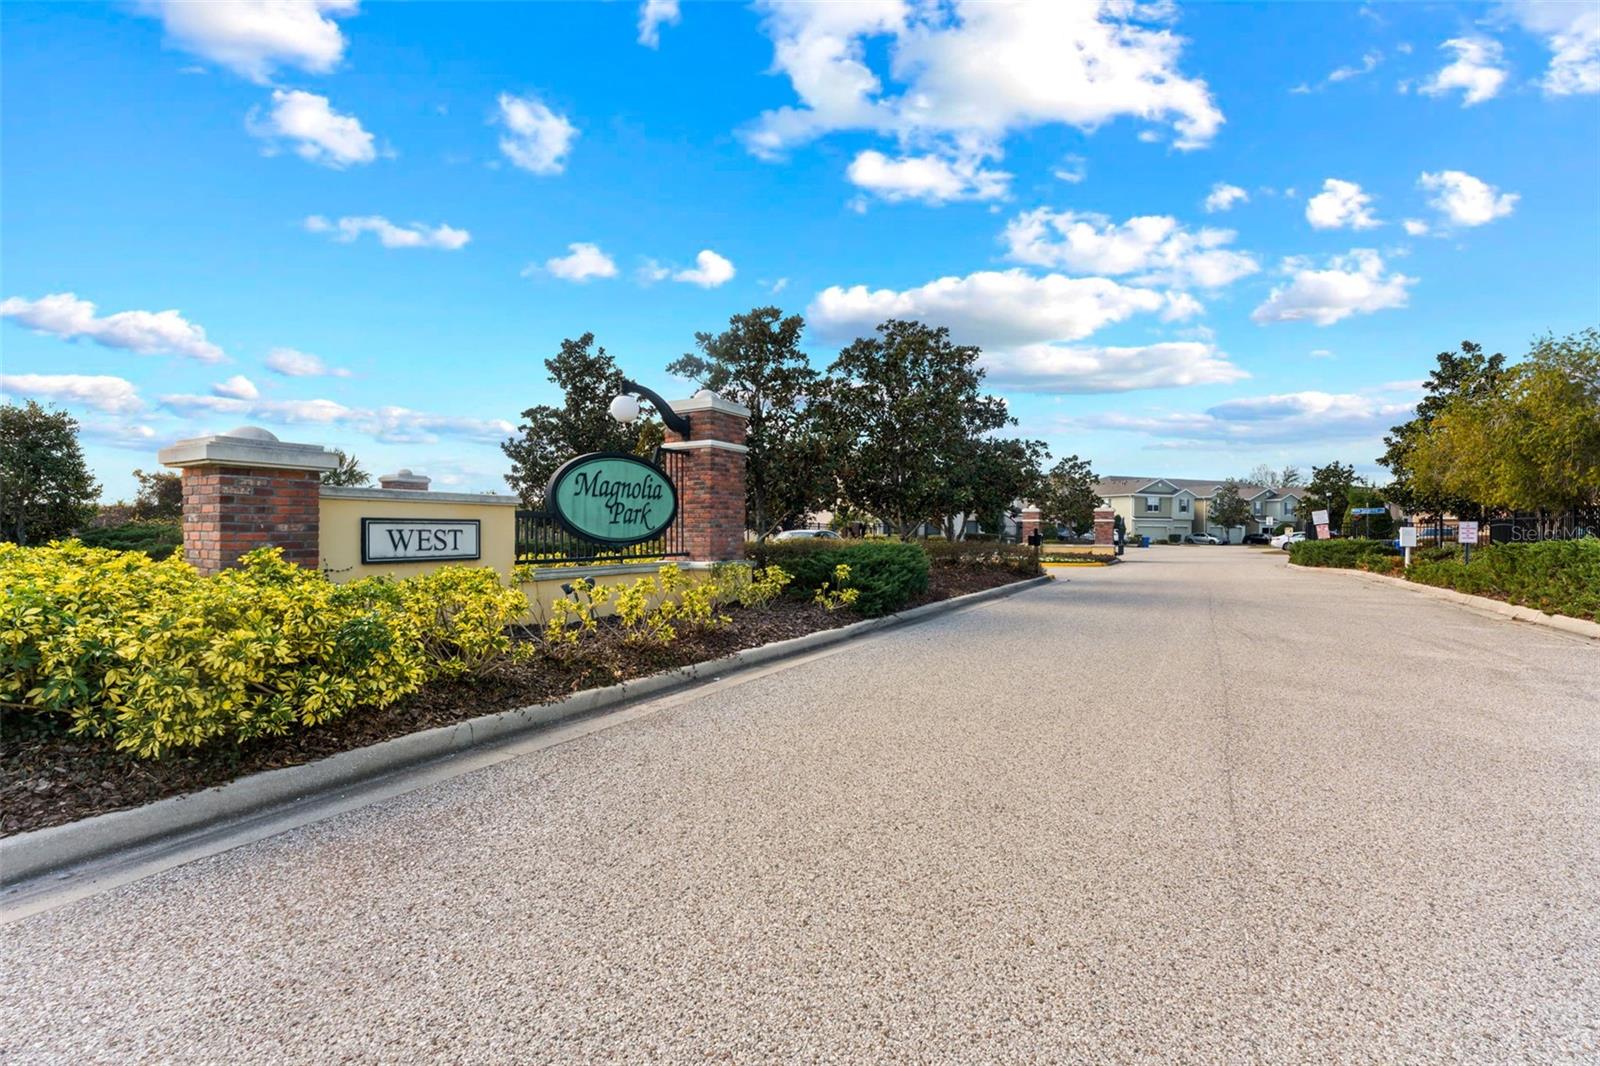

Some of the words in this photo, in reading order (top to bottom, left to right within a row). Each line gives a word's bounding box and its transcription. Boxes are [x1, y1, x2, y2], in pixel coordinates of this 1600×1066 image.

[574, 470, 663, 508] Magnolia
[608, 502, 656, 530] Park
[386, 529, 464, 552] WEST
